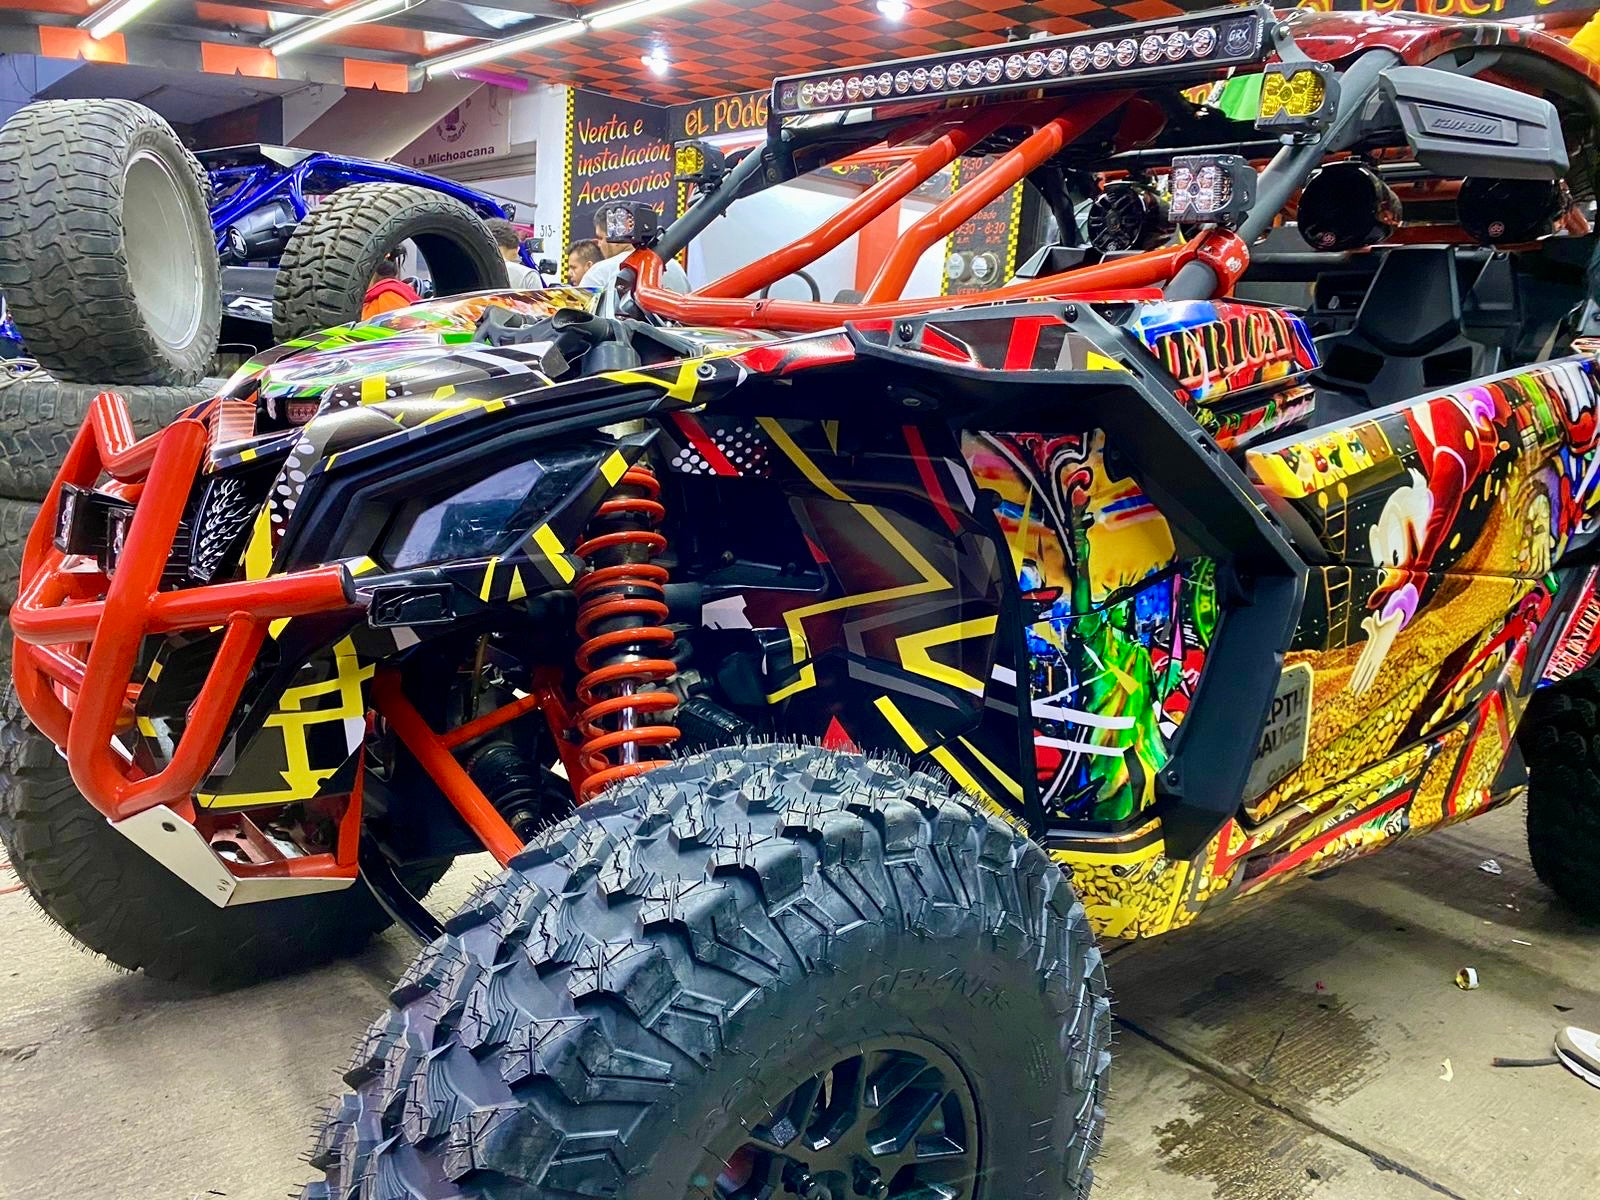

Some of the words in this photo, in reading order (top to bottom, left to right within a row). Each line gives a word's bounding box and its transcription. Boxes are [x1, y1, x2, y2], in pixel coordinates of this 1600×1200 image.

[578, 113, 629, 146] Venta
[632, 118, 643, 134] e
[1432, 118, 1497, 135] can-am
[412, 155, 425, 167] La
[429, 145, 495, 164] Michoacana
[577, 138, 671, 177] instalación
[961, 157, 983, 171] 9:30
[577, 170, 671, 206] Accesorios
[984, 221, 1006, 234] 8:30
[1266, 687, 1305, 726] PTH
